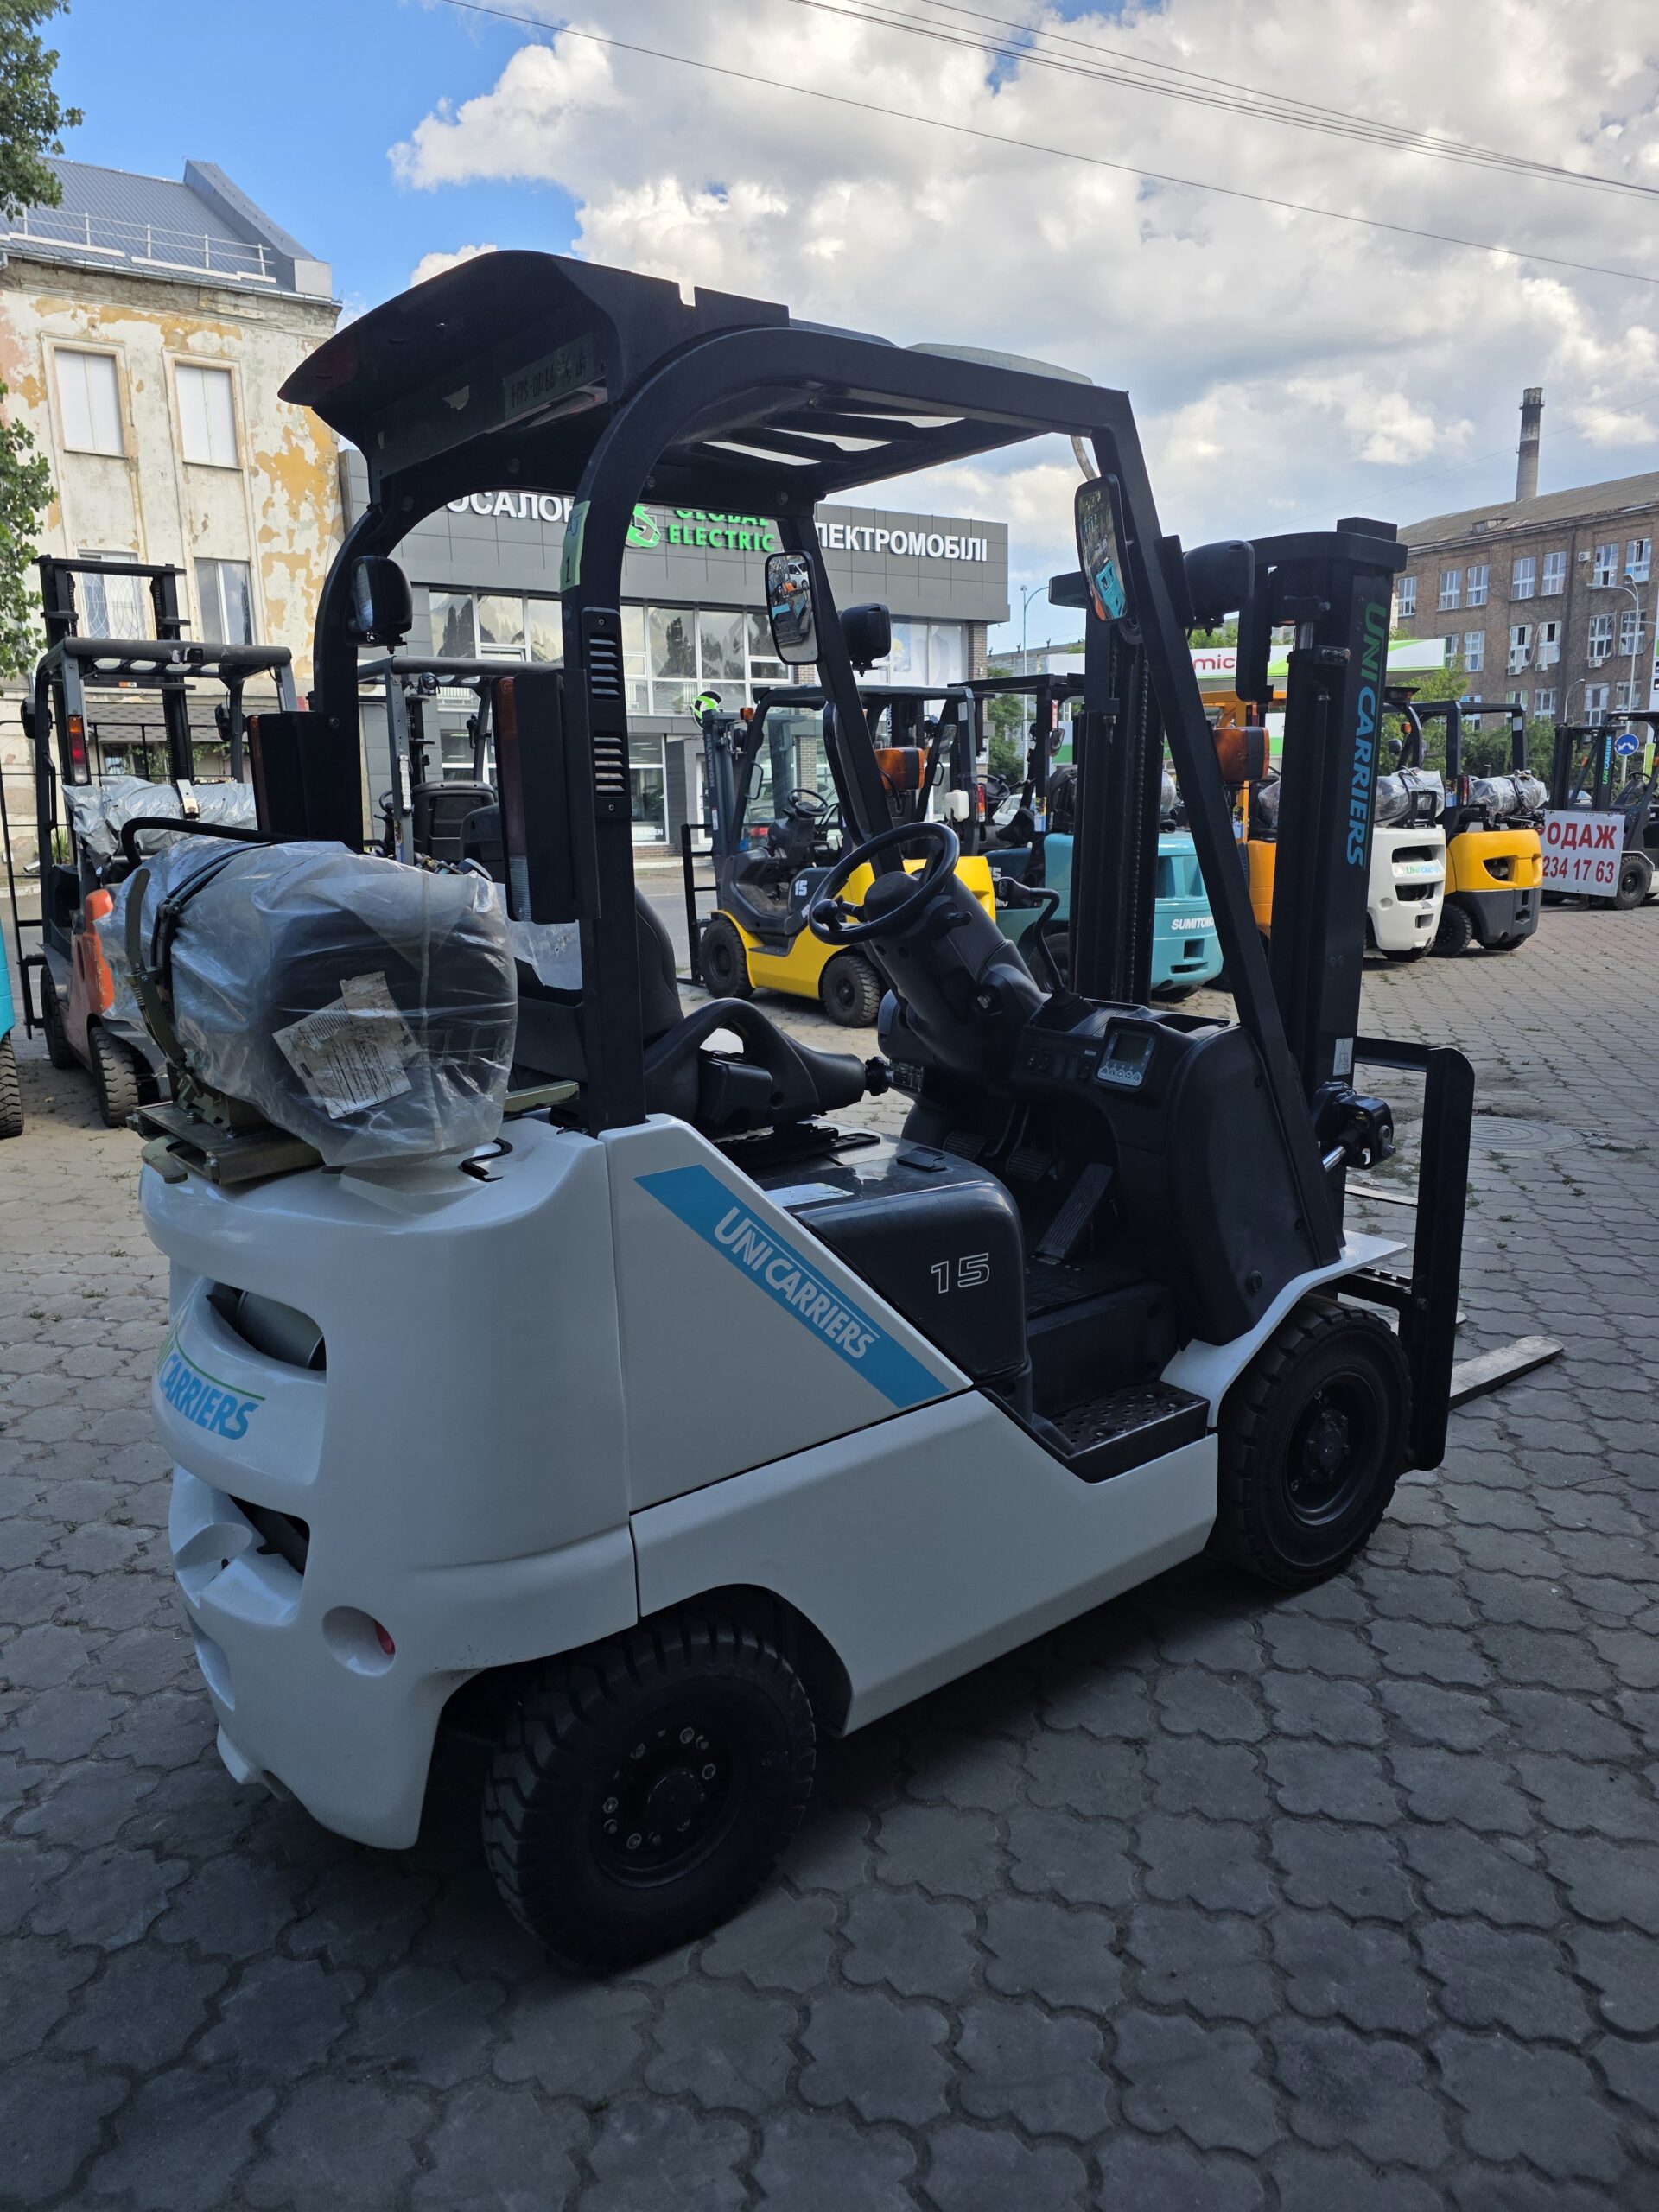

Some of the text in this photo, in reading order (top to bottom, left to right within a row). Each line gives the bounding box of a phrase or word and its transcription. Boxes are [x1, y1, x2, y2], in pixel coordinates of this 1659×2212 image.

[669, 524, 775, 552] ELECTRIC
[1193, 653, 1236, 671] mic
[1542, 855, 1614, 884] 234 17 63
[794, 880, 808, 896] 15
[931, 1251, 989, 1294] 15
[156, 1335, 259, 1440] CARRIERS
